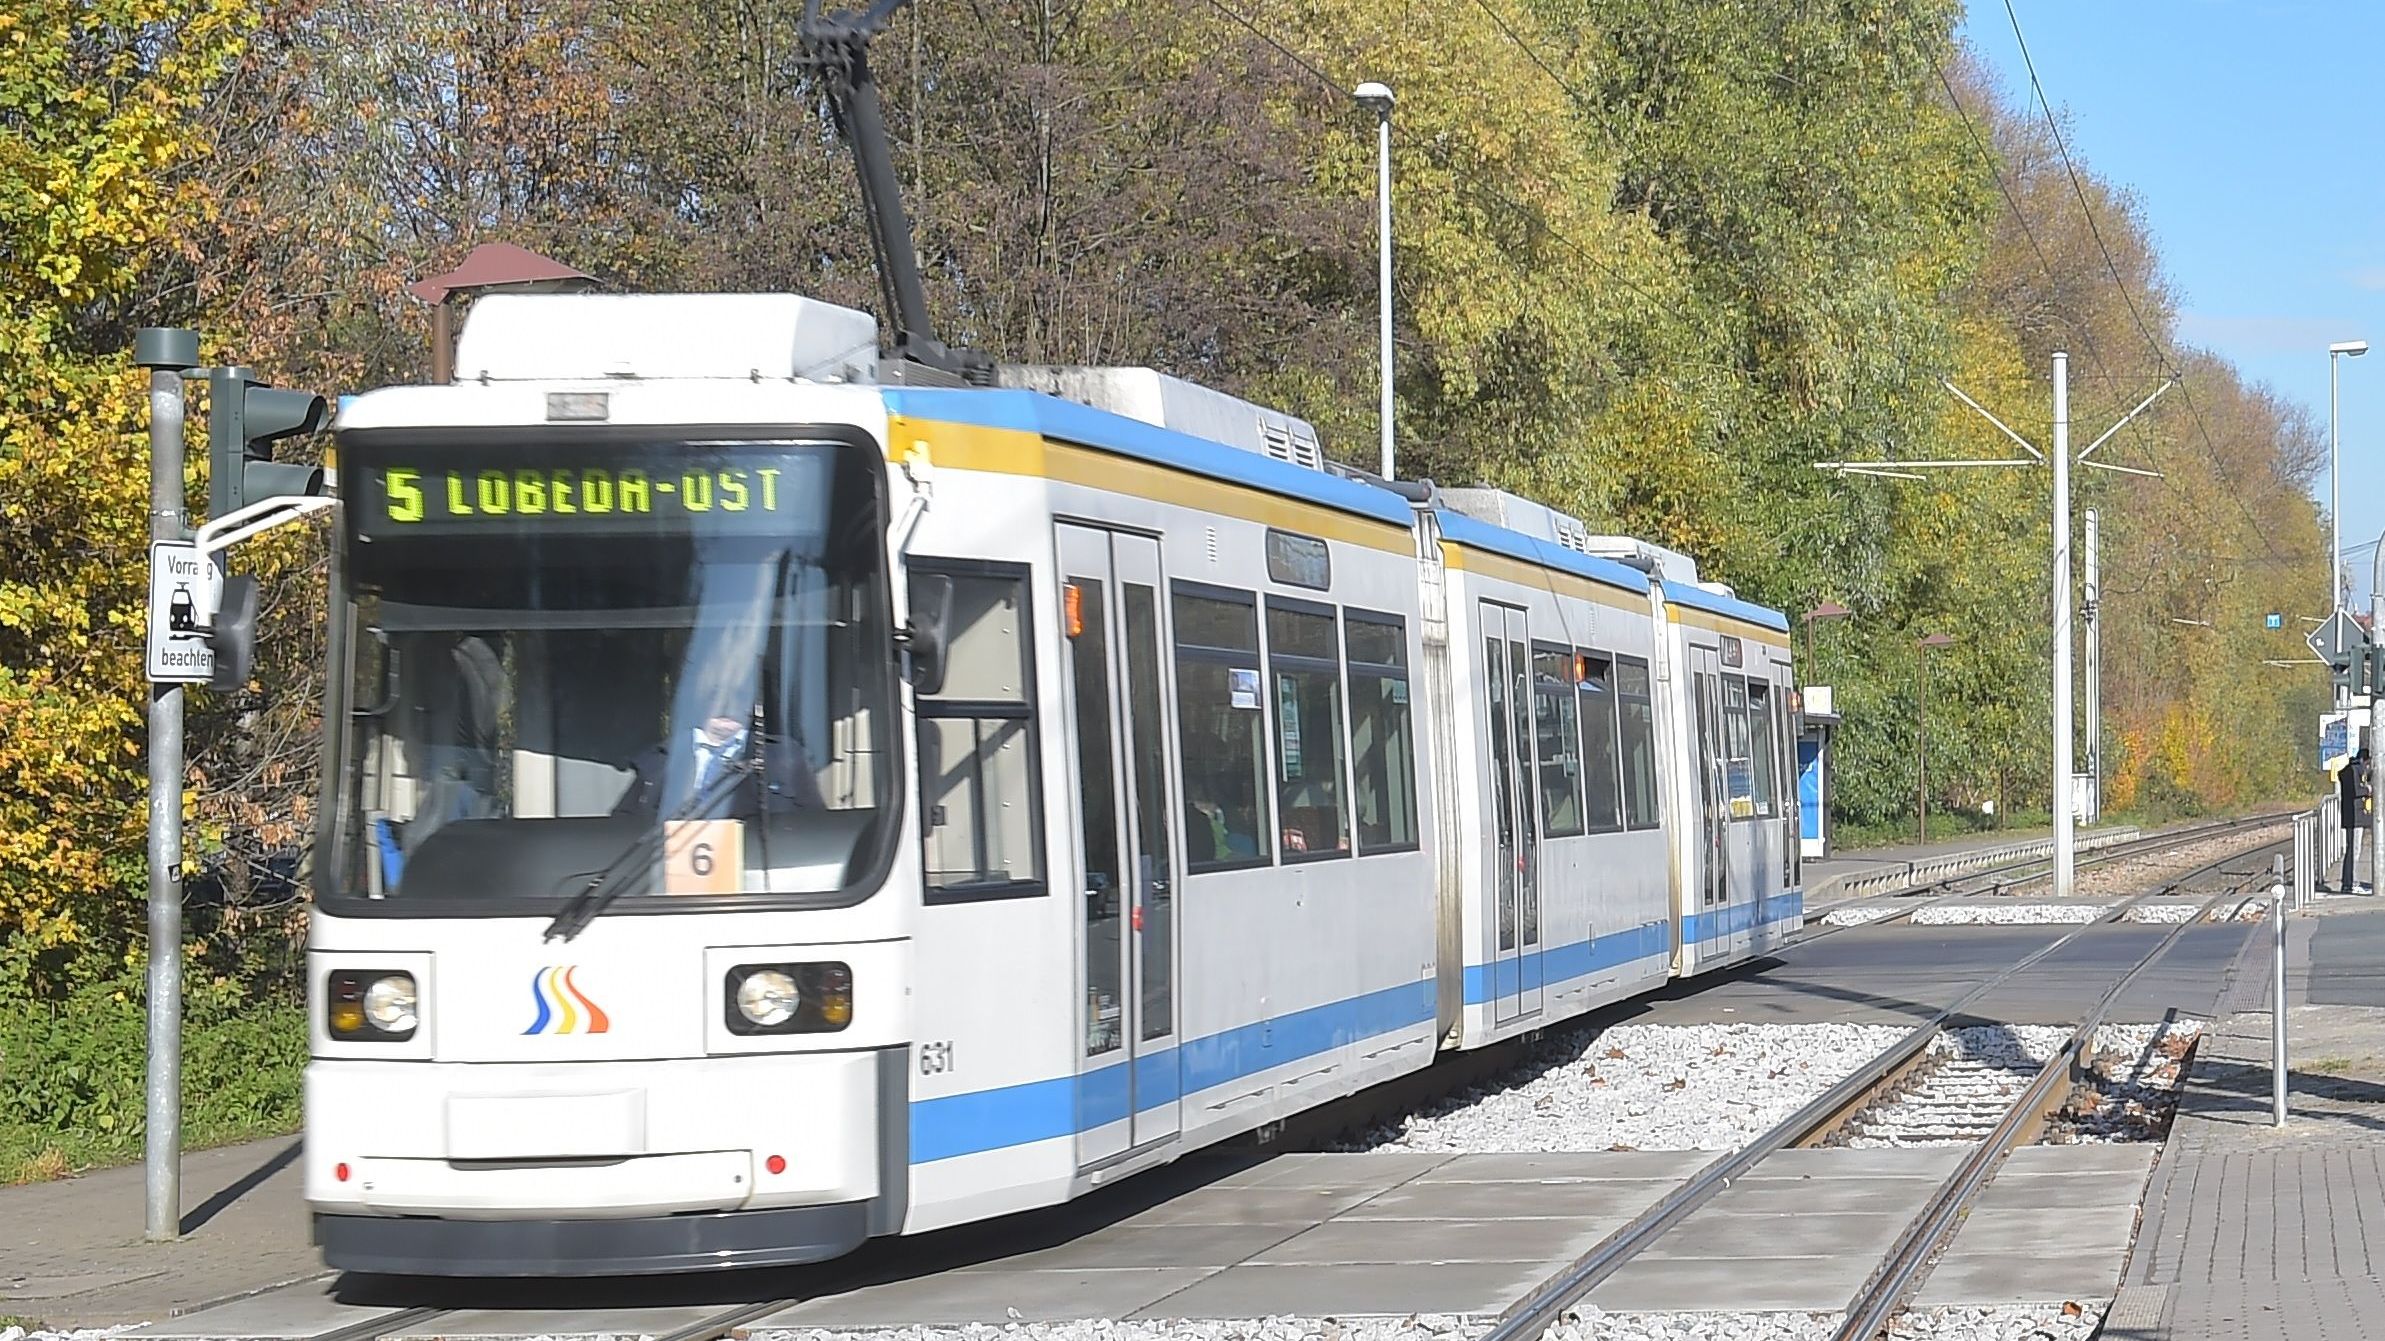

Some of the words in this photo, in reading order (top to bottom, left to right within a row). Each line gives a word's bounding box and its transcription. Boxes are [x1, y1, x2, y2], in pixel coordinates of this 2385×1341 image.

[385, 469, 424, 521] 5
[446, 469, 781, 514] LOBEDA-OST
[168, 555, 213, 580] Vorrag
[161, 647, 213, 667] beachten
[692, 842, 714, 876] 6
[920, 1040, 954, 1075] 631
